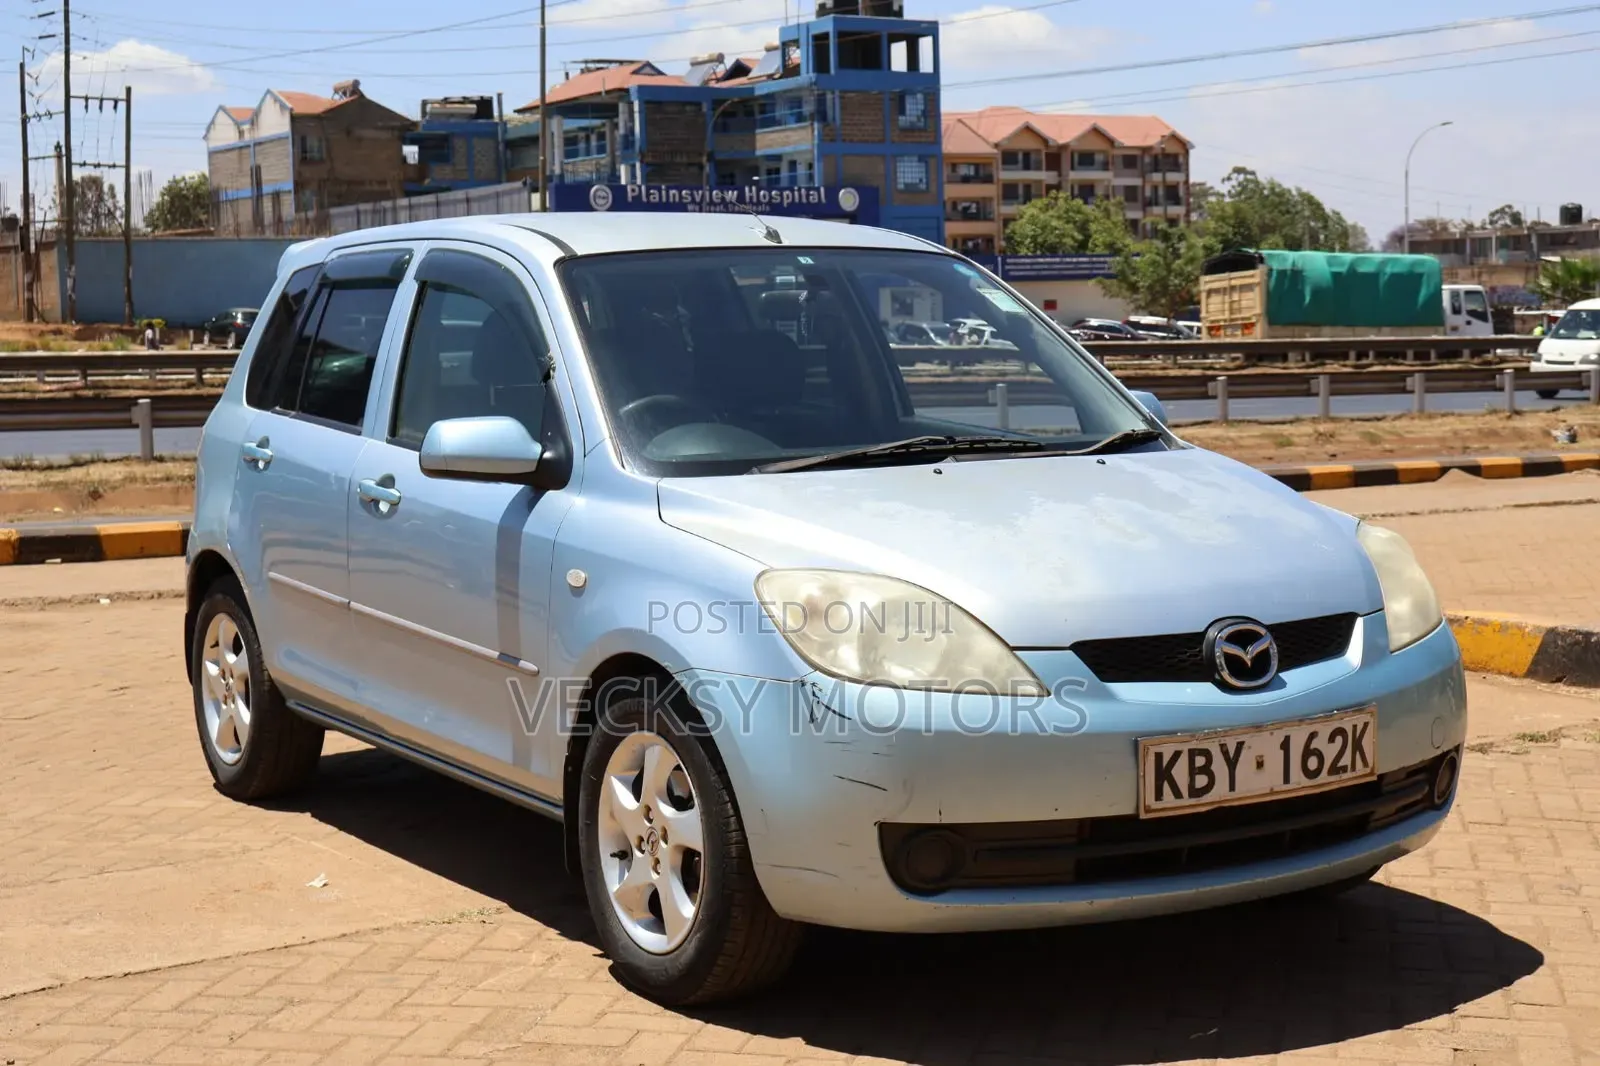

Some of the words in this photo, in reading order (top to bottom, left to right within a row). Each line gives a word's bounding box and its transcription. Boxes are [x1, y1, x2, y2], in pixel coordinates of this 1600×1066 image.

[627, 184, 738, 203] Plainsview
[745, 185, 826, 208] Hospital
[1154, 740, 1245, 802] KBY
[1280, 721, 1370, 785] 162K
